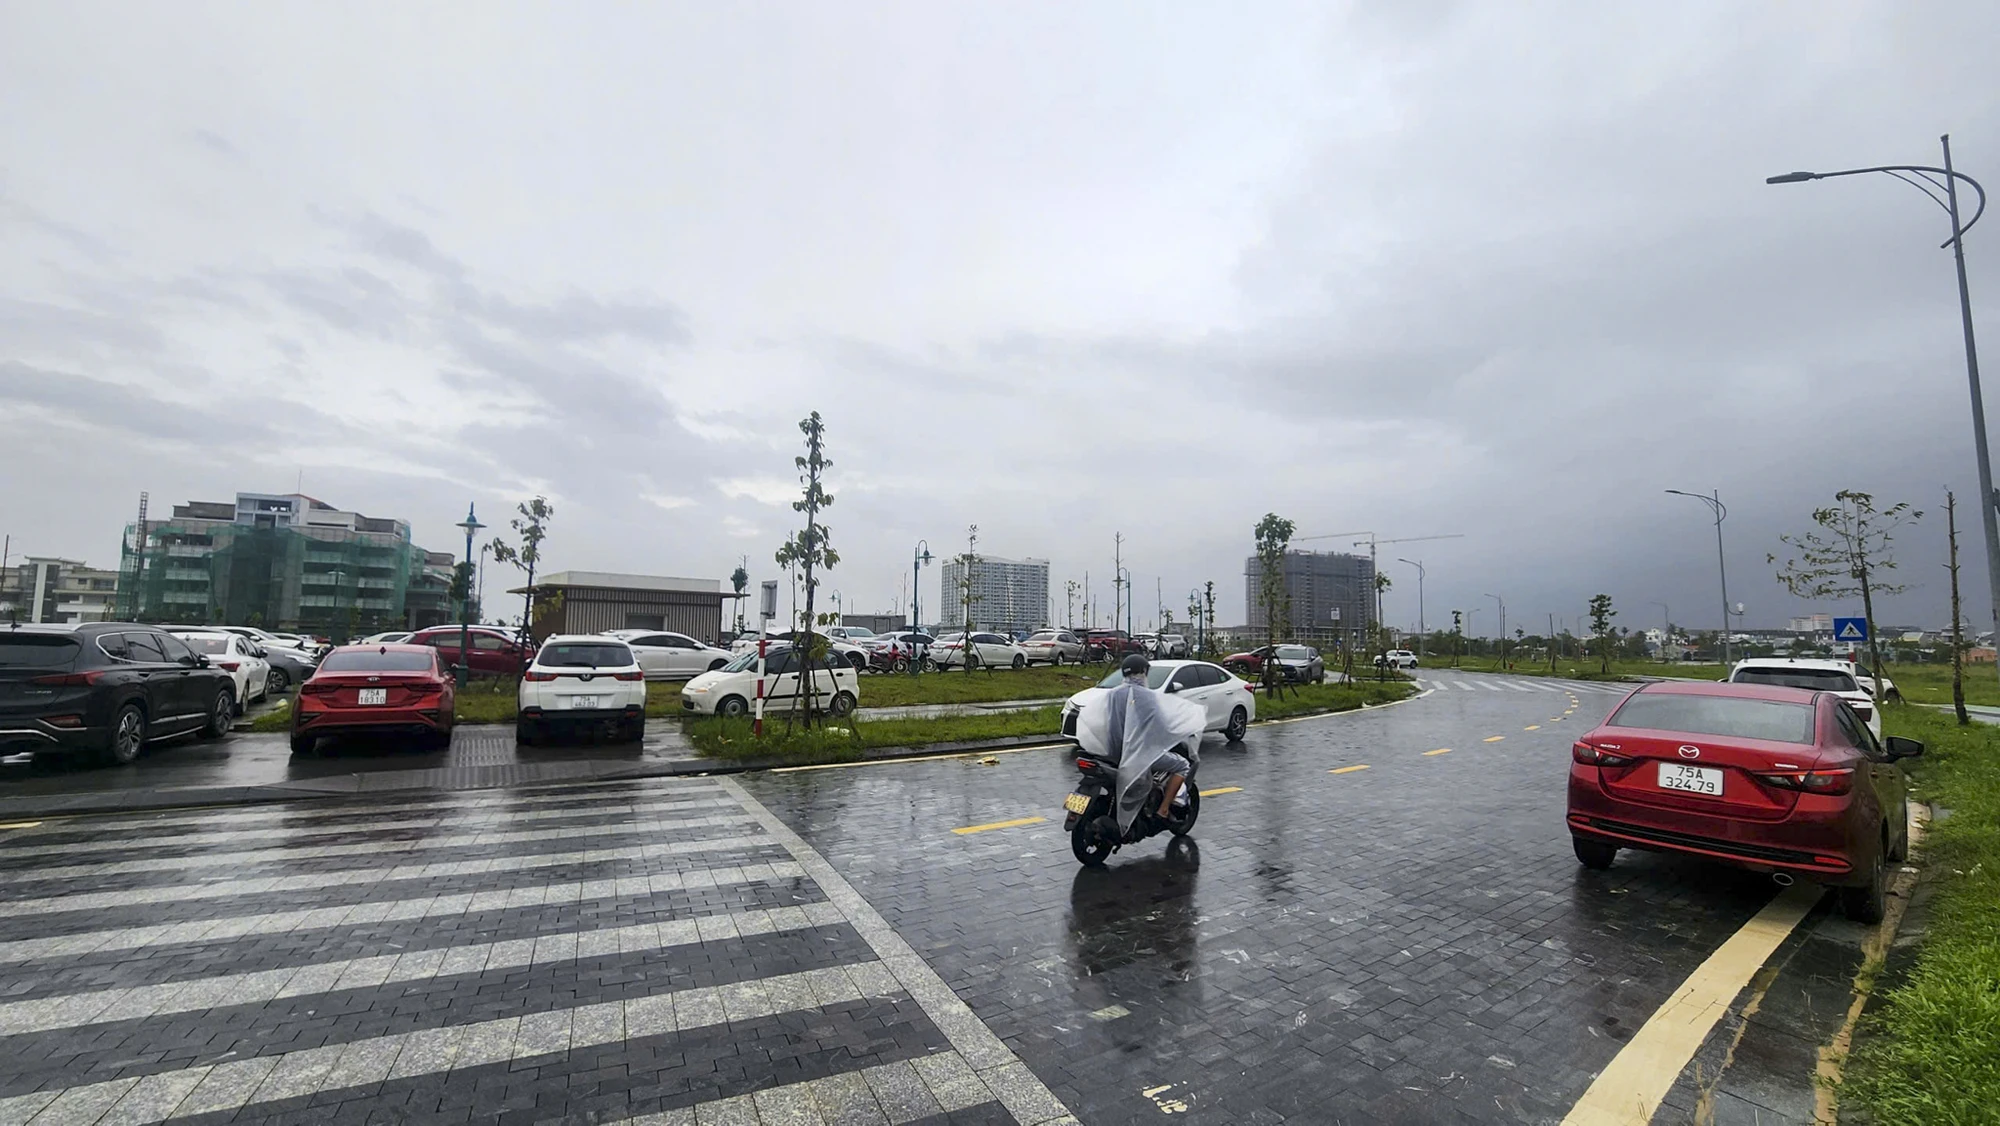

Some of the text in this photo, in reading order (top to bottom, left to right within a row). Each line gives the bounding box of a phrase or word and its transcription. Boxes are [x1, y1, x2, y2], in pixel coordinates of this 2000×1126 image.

[366, 689, 380, 697] 75A
[1677, 766, 1703, 779] 75A
[1665, 776, 1715, 793] 324.79
